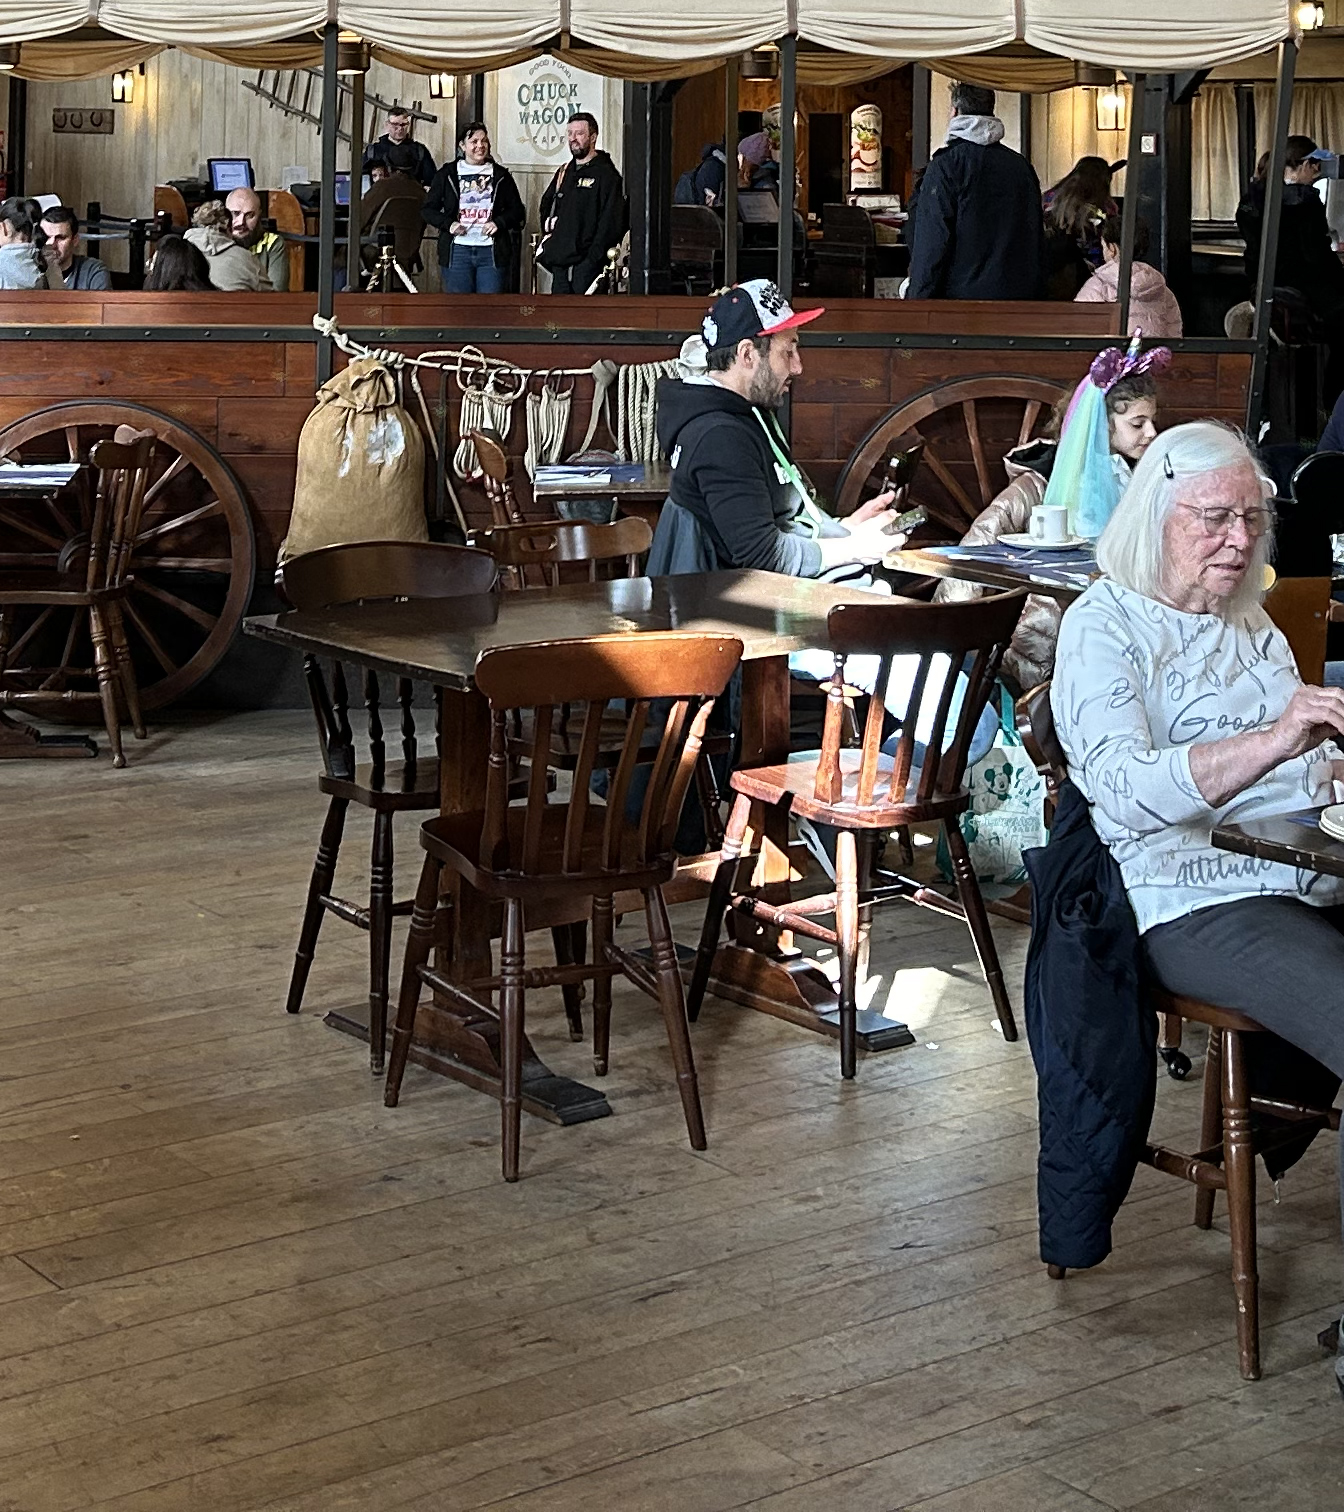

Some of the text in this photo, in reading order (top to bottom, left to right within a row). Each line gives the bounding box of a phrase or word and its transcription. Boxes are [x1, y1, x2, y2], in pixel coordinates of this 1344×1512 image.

[529, 58, 550, 76] GOOD
[517, 82, 579, 107] CHUCK
[1168, 692, 1279, 745] Good
